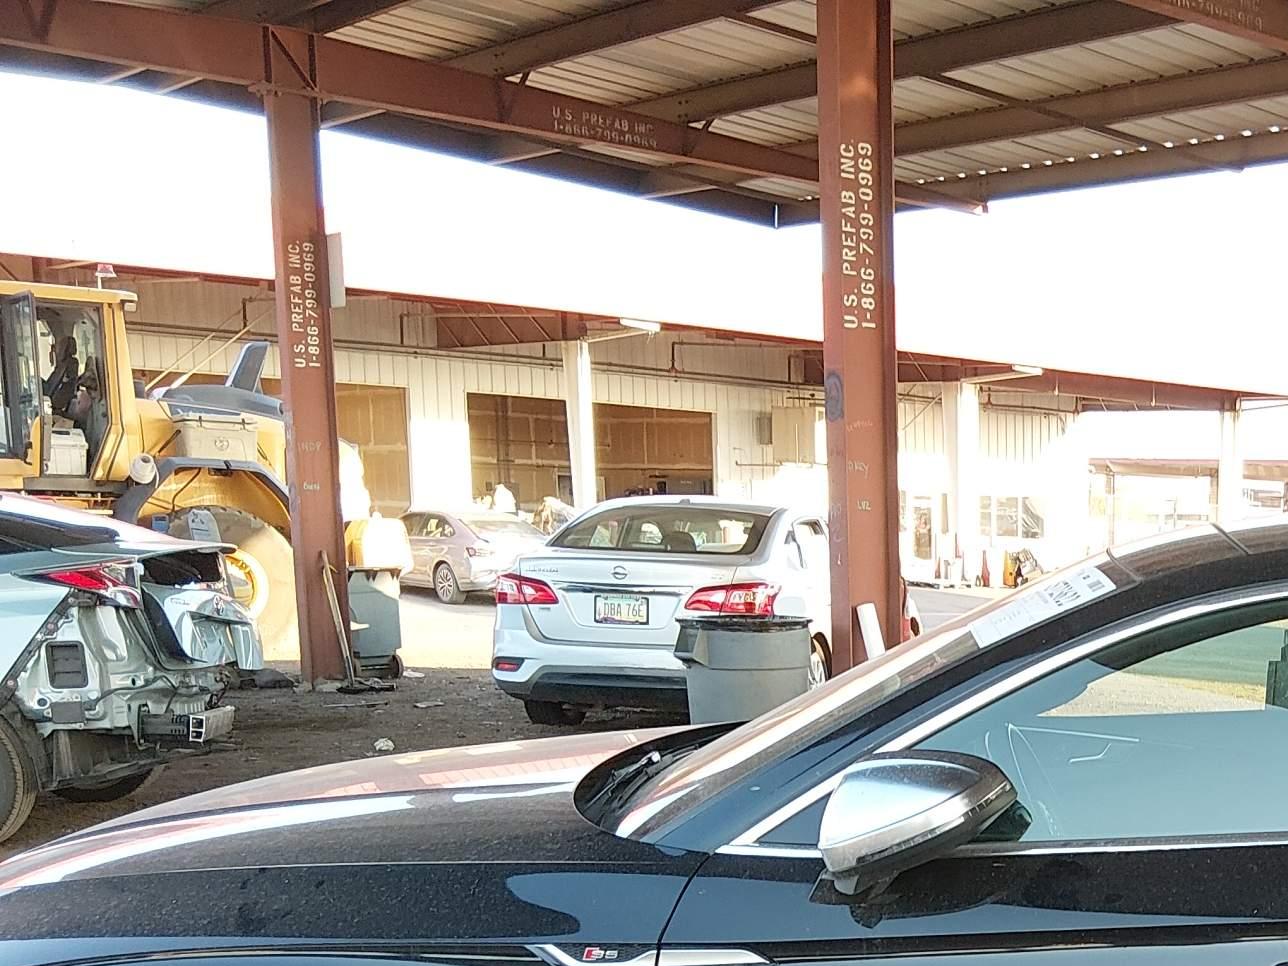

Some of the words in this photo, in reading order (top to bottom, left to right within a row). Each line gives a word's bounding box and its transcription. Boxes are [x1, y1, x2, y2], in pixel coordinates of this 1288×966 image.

[552, 105, 577, 121] U.S.
[582, 111, 629, 132] PREFAB
[840, 139, 855, 180] INC.
[841, 190, 857, 276] PREFAB
[858, 142, 876, 328] 1-866-799-0969
[287, 240, 301, 268] INC.
[289, 275, 304, 332] PREFAB
[302, 242, 320, 367] 1-866-799-0969
[843, 288, 858, 329] U.S.
[293, 340, 306, 368] U.S.
